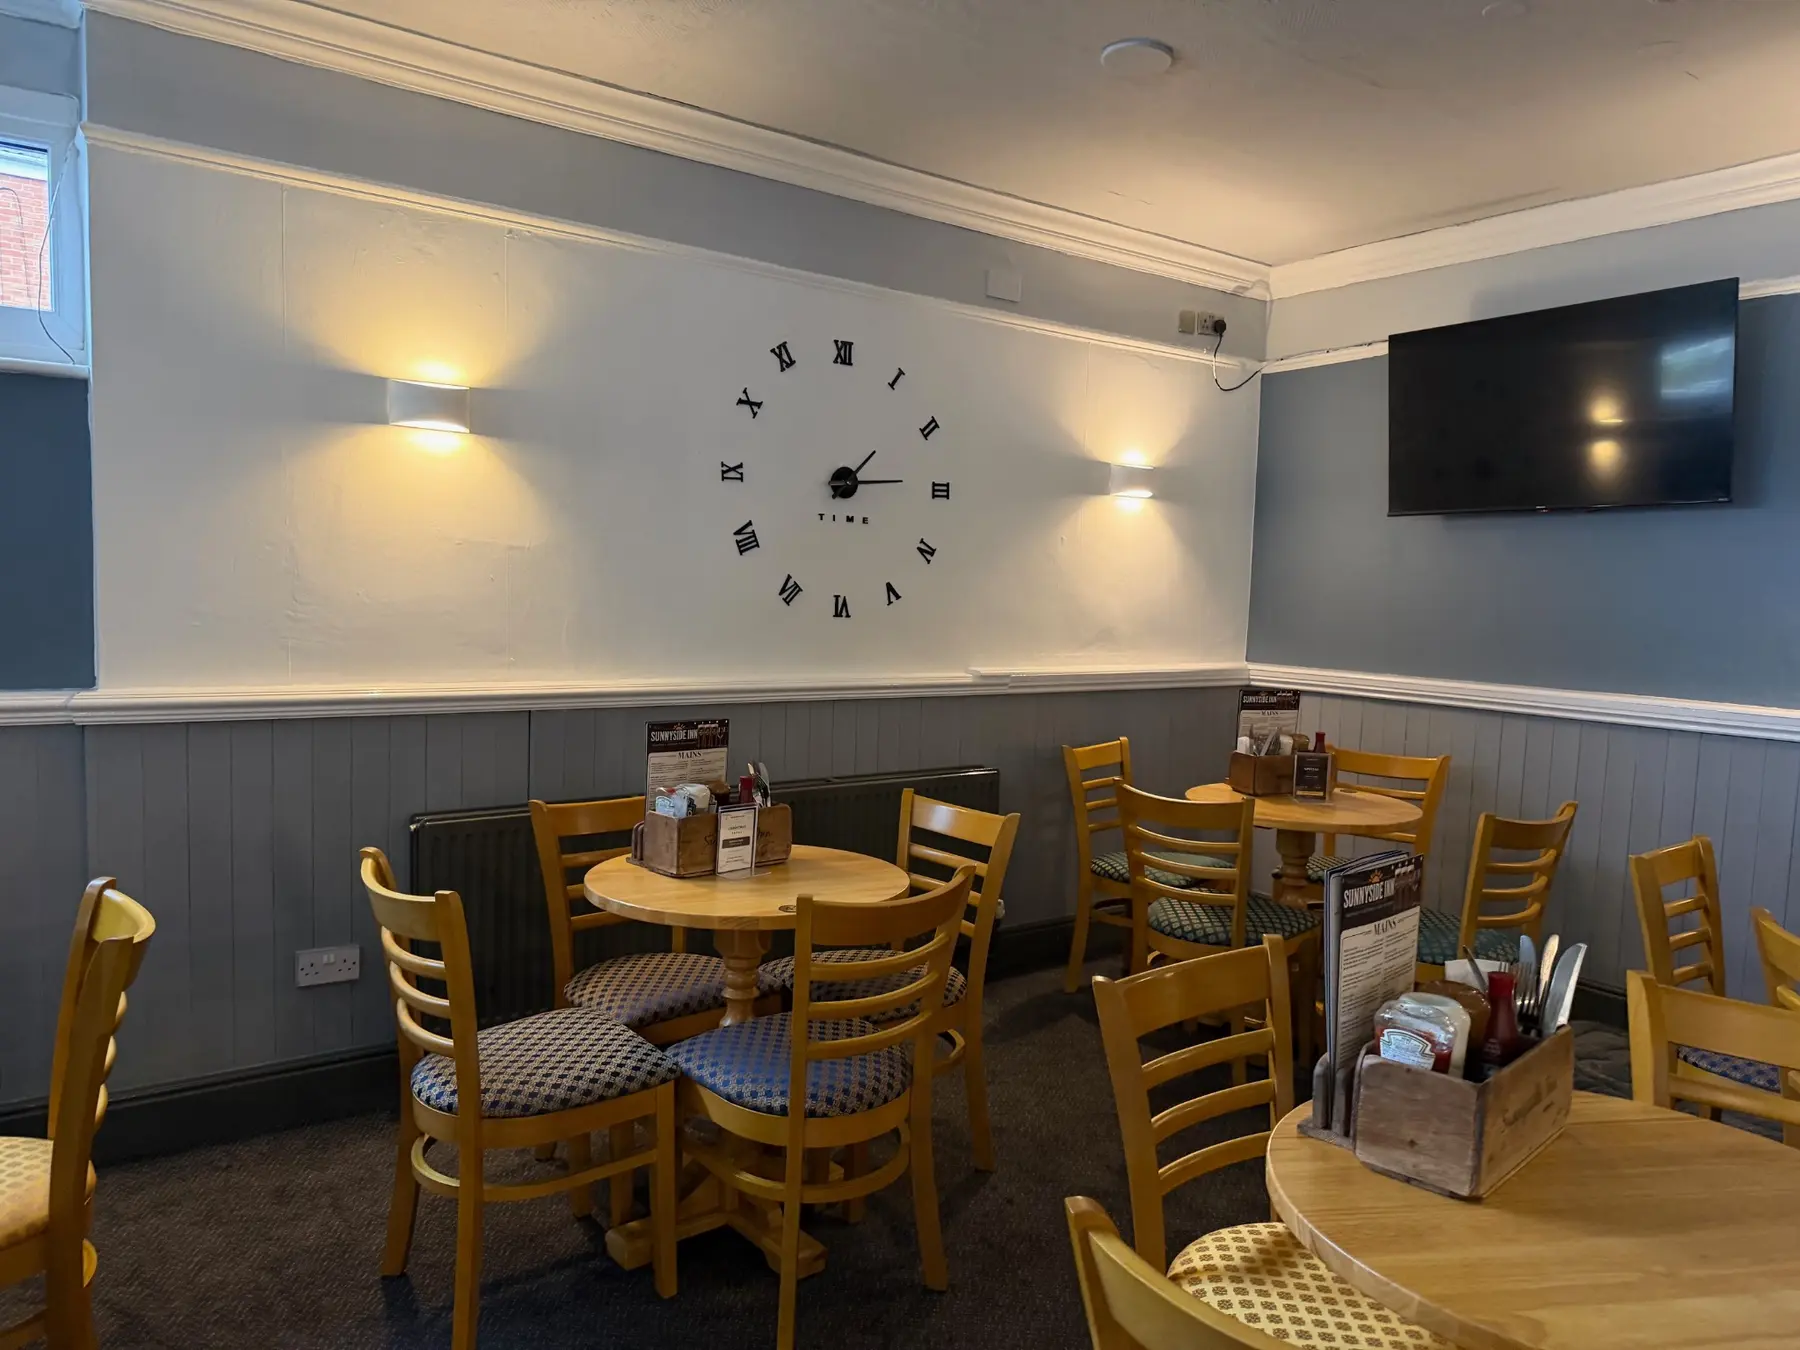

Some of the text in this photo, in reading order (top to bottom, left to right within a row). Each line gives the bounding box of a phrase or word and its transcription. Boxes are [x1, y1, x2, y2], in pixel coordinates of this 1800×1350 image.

[770, 341, 796, 372] XI
[833, 339, 854, 366] XII
[888, 367, 906, 390] I
[736, 387, 763, 419] X
[919, 416, 940, 440] II
[721, 461, 743, 482] IX
[932, 481, 950, 500] III
[817, 513, 869, 525] TIME
[733, 520, 760, 556] VIII
[779, 574, 803, 606] VII
[886, 582, 902, 606] V
[833, 595, 851, 618] VI
[650, 729, 698, 742] SUNNYSIDE INN
[678, 751, 702, 759] MAINS
[1343, 878, 1396, 909] SUNNYSIDE INN
[1373, 917, 1397, 936] MAINS
